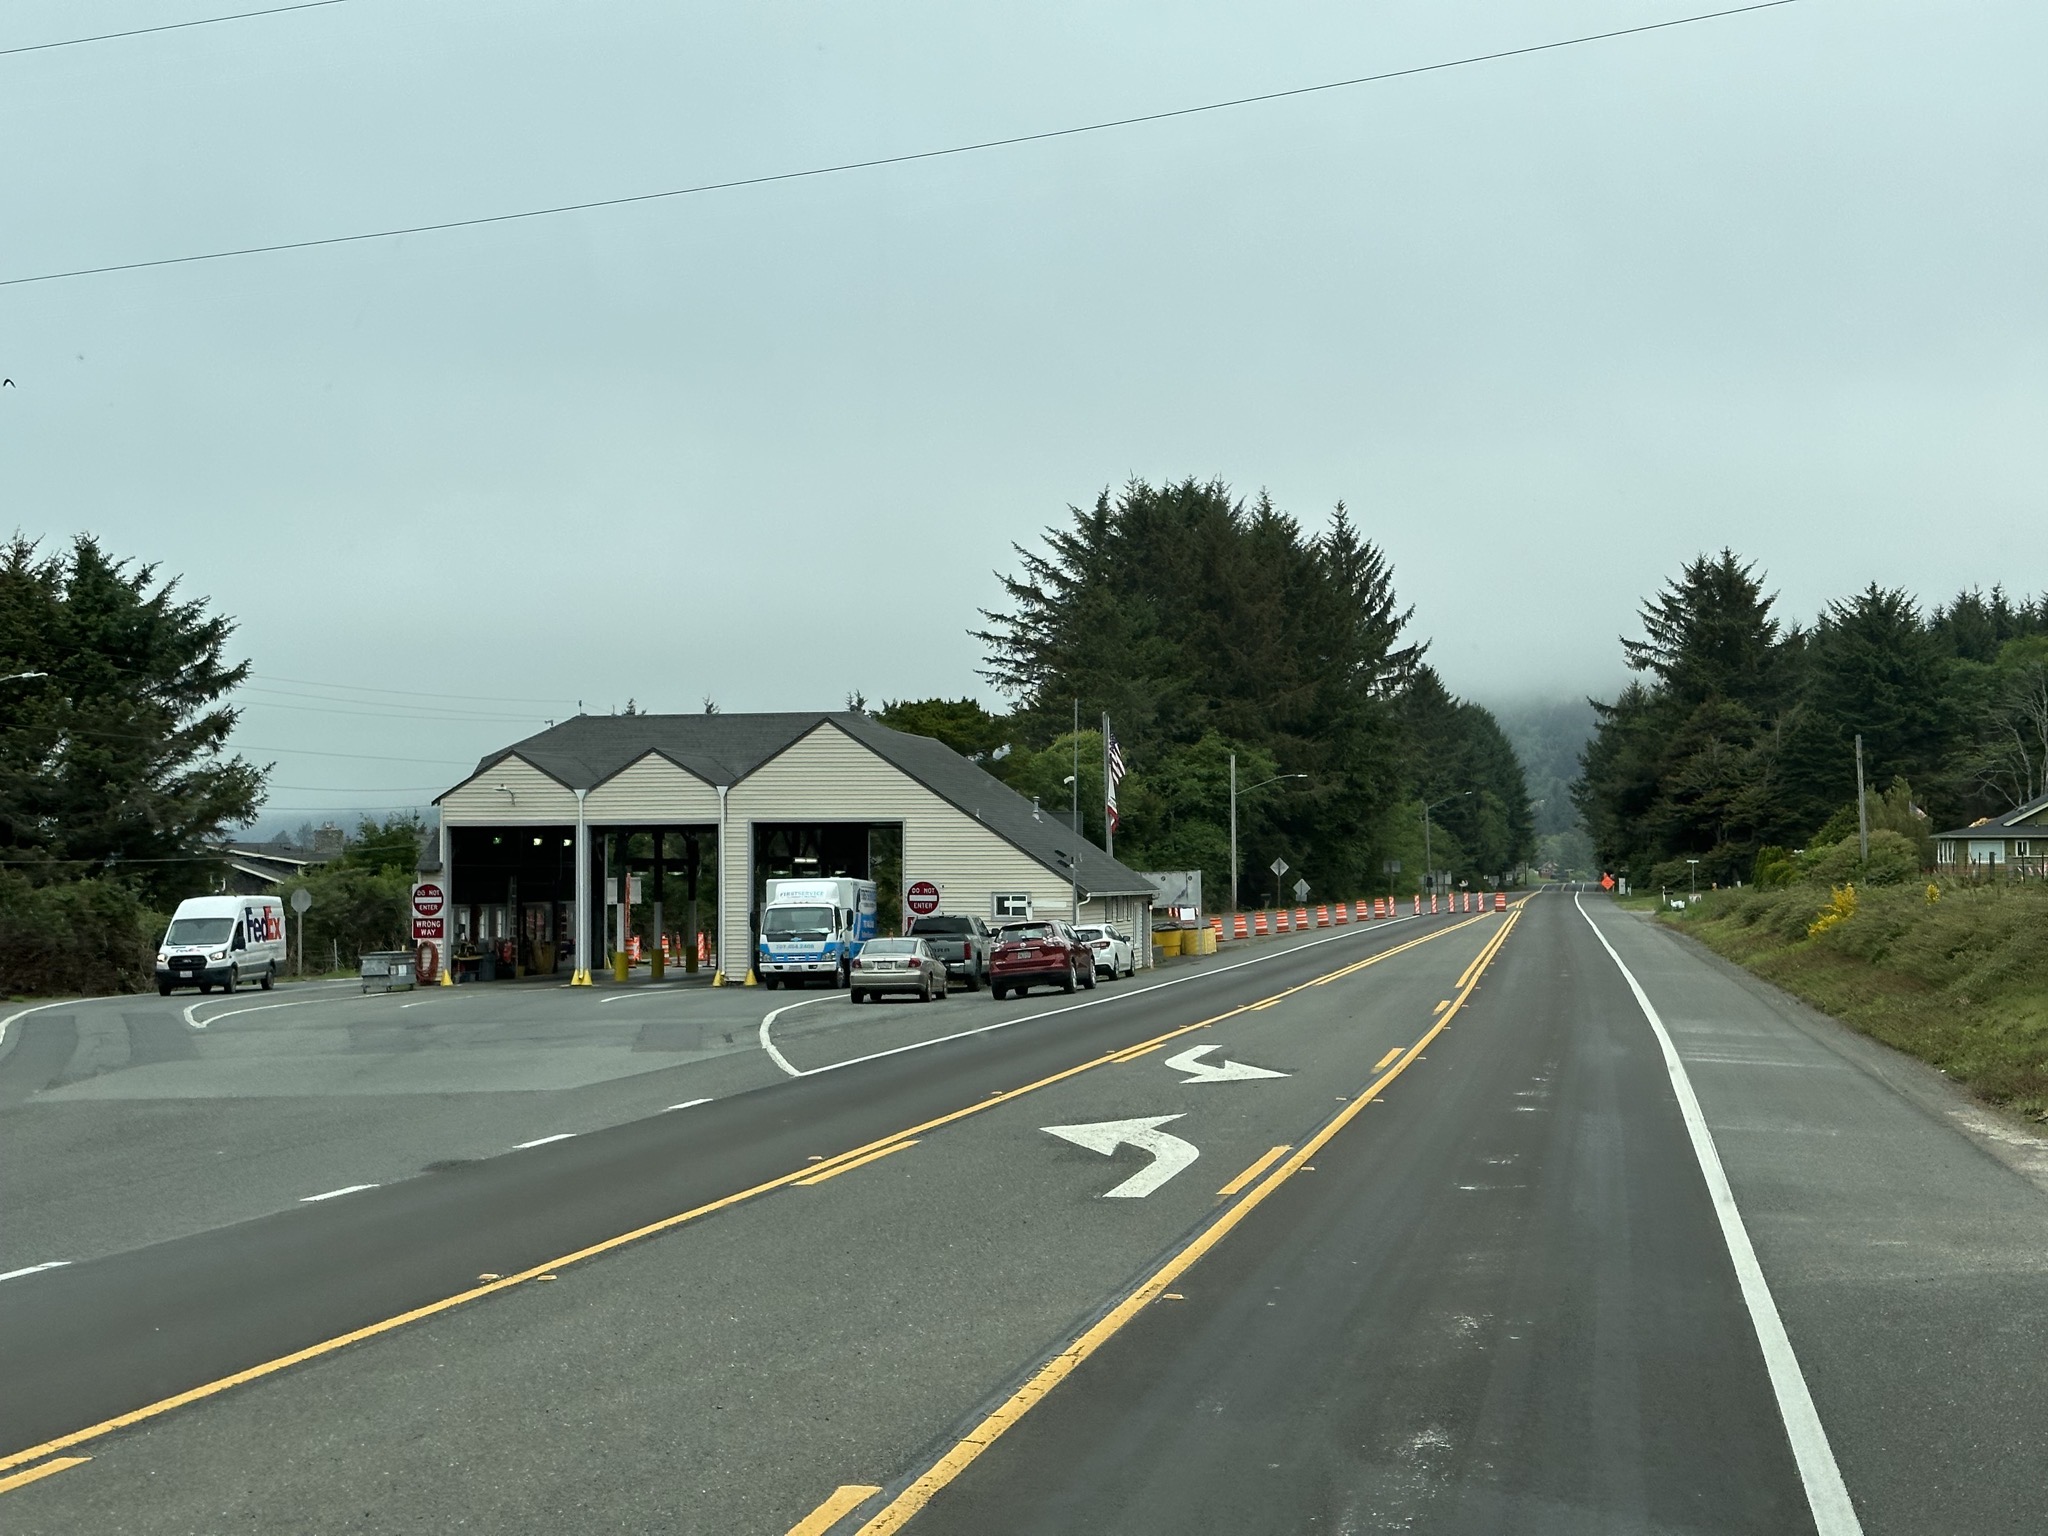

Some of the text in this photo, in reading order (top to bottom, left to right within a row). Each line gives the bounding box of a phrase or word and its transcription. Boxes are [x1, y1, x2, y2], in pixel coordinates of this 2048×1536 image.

[416, 889, 426, 897] DO
[245, 906, 282, 943] FedEx
[416, 920, 441, 928] WRONG
